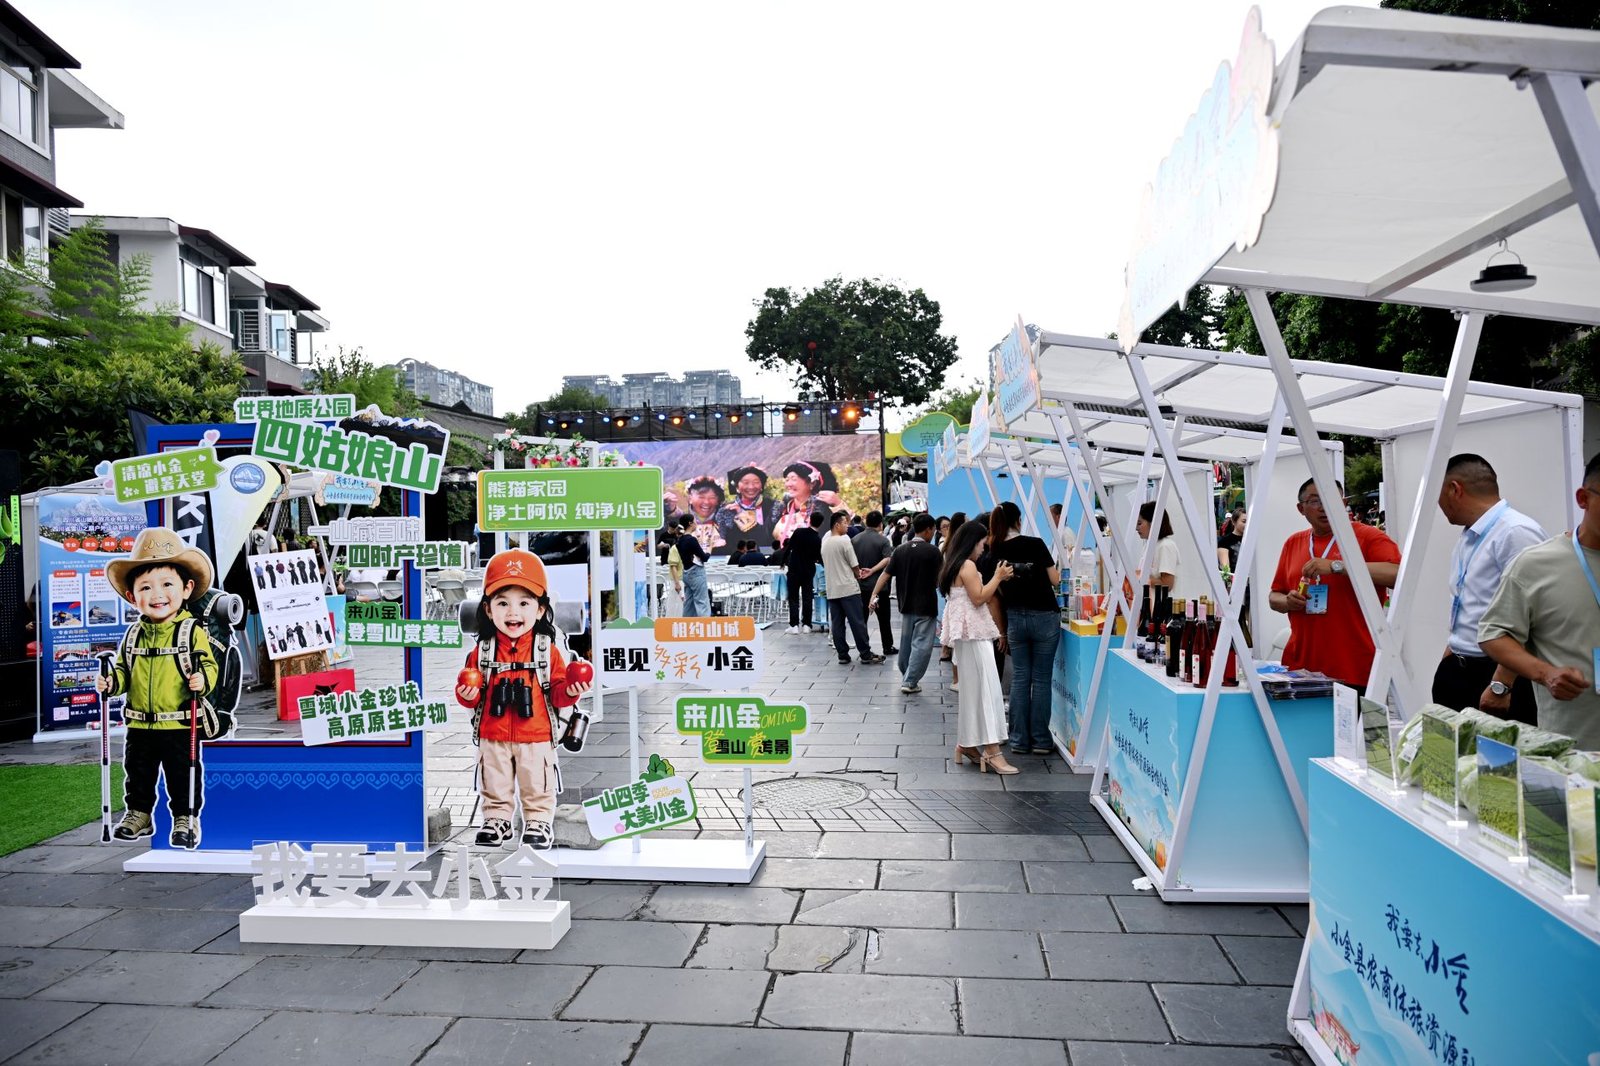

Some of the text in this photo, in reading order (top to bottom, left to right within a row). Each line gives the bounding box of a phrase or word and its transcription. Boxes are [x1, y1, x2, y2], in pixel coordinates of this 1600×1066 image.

[237, 398, 352, 420] 世界地质公园
[255, 418, 440, 490] 四姑娘山
[121, 458, 183, 482] 清凉小金
[144, 470, 206, 494] 避暑天堂
[487, 480, 567, 498] 熊猫家园
[487, 501, 657, 522] 净土阿坝 纯净小金
[309, 518, 420, 543] 一山藏百味
[350, 544, 462, 567] 四时产珍馐
[347, 605, 397, 620] 来小金
[347, 622, 461, 645] 登雪山赏美景
[671, 621, 740, 639] 相约山城
[299, 682, 420, 720] 雪域小金珍味
[327, 702, 448, 739] 高原原生好物
[683, 703, 761, 729] 来小金
[583, 781, 650, 812] 一山四季
[619, 797, 688, 832] 大美小金
[251, 840, 559, 911] 我要去小金
[1385, 903, 1470, 1015] 我要去小金
